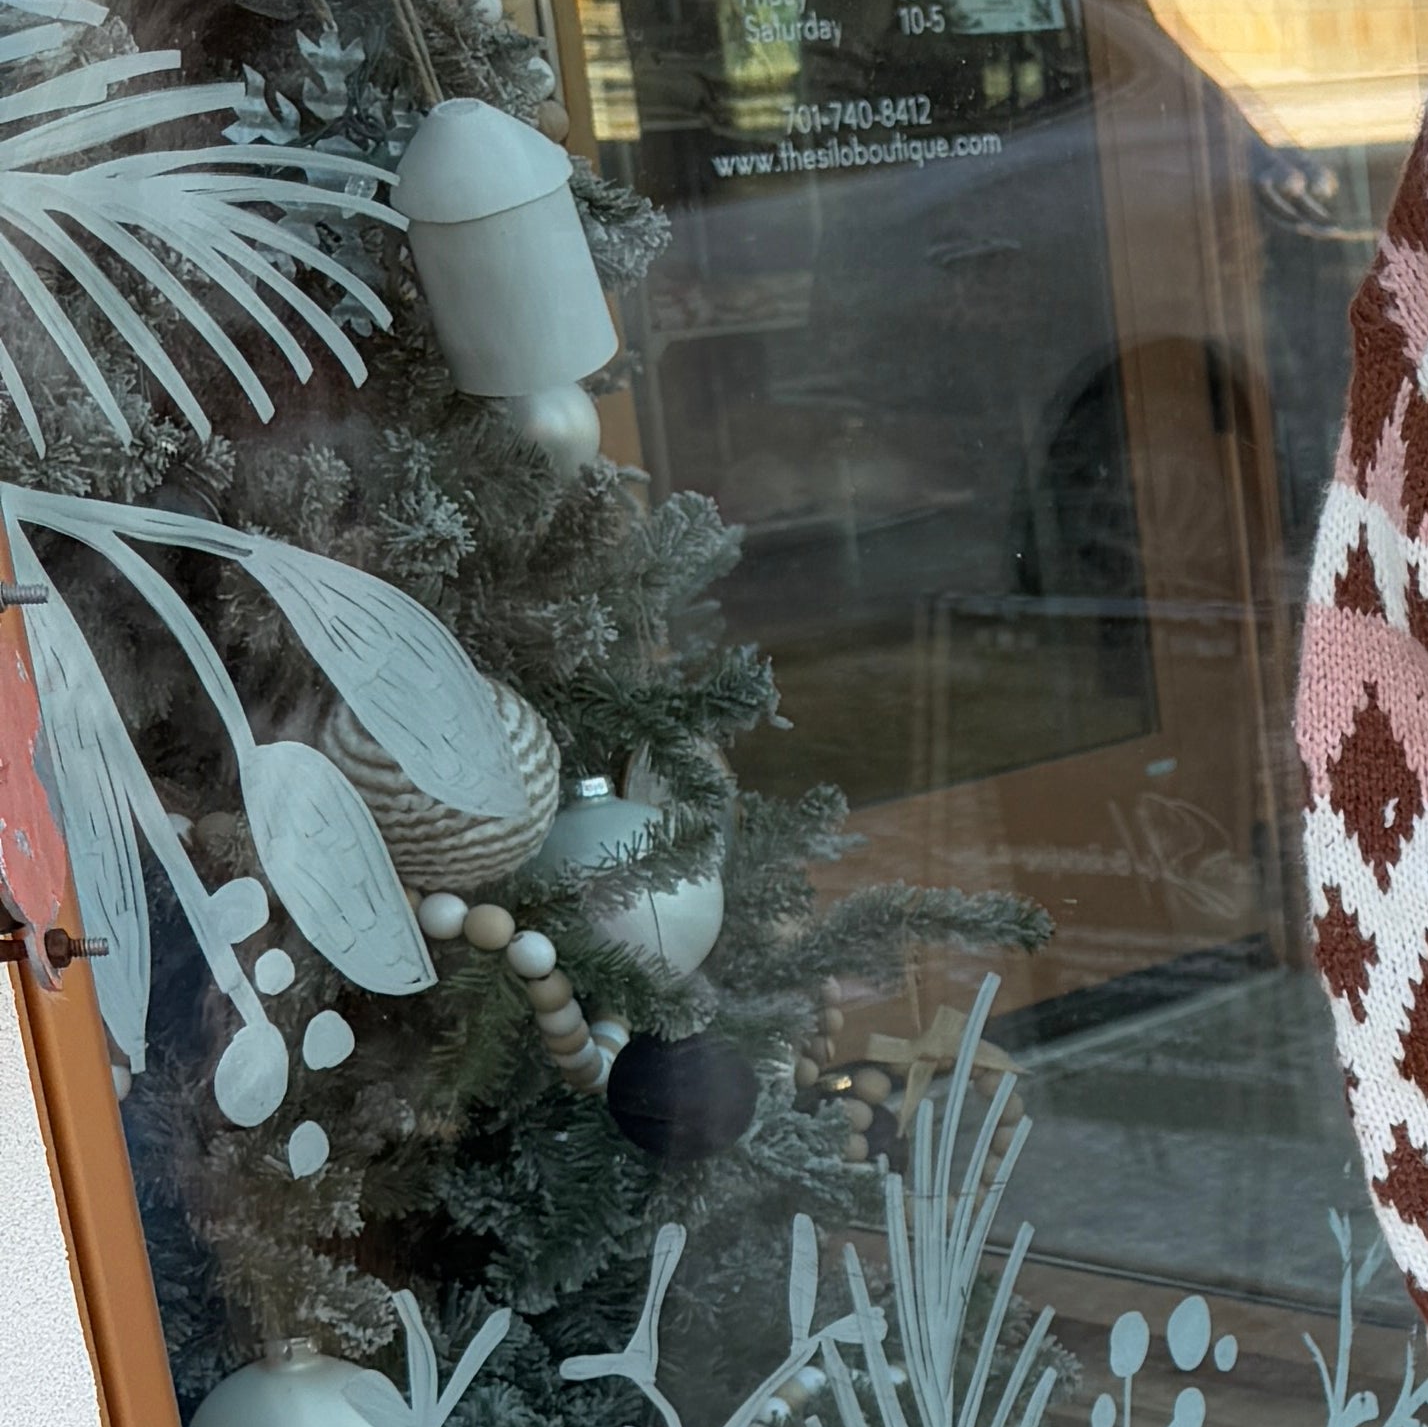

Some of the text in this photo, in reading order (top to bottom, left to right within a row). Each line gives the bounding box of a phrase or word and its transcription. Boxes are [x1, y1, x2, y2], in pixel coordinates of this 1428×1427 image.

[744, 4, 946, 49] Saturday 10-5
[783, 93, 933, 136] 701-740-8412
[711, 131, 1003, 178] www.thesiloboutique.com
